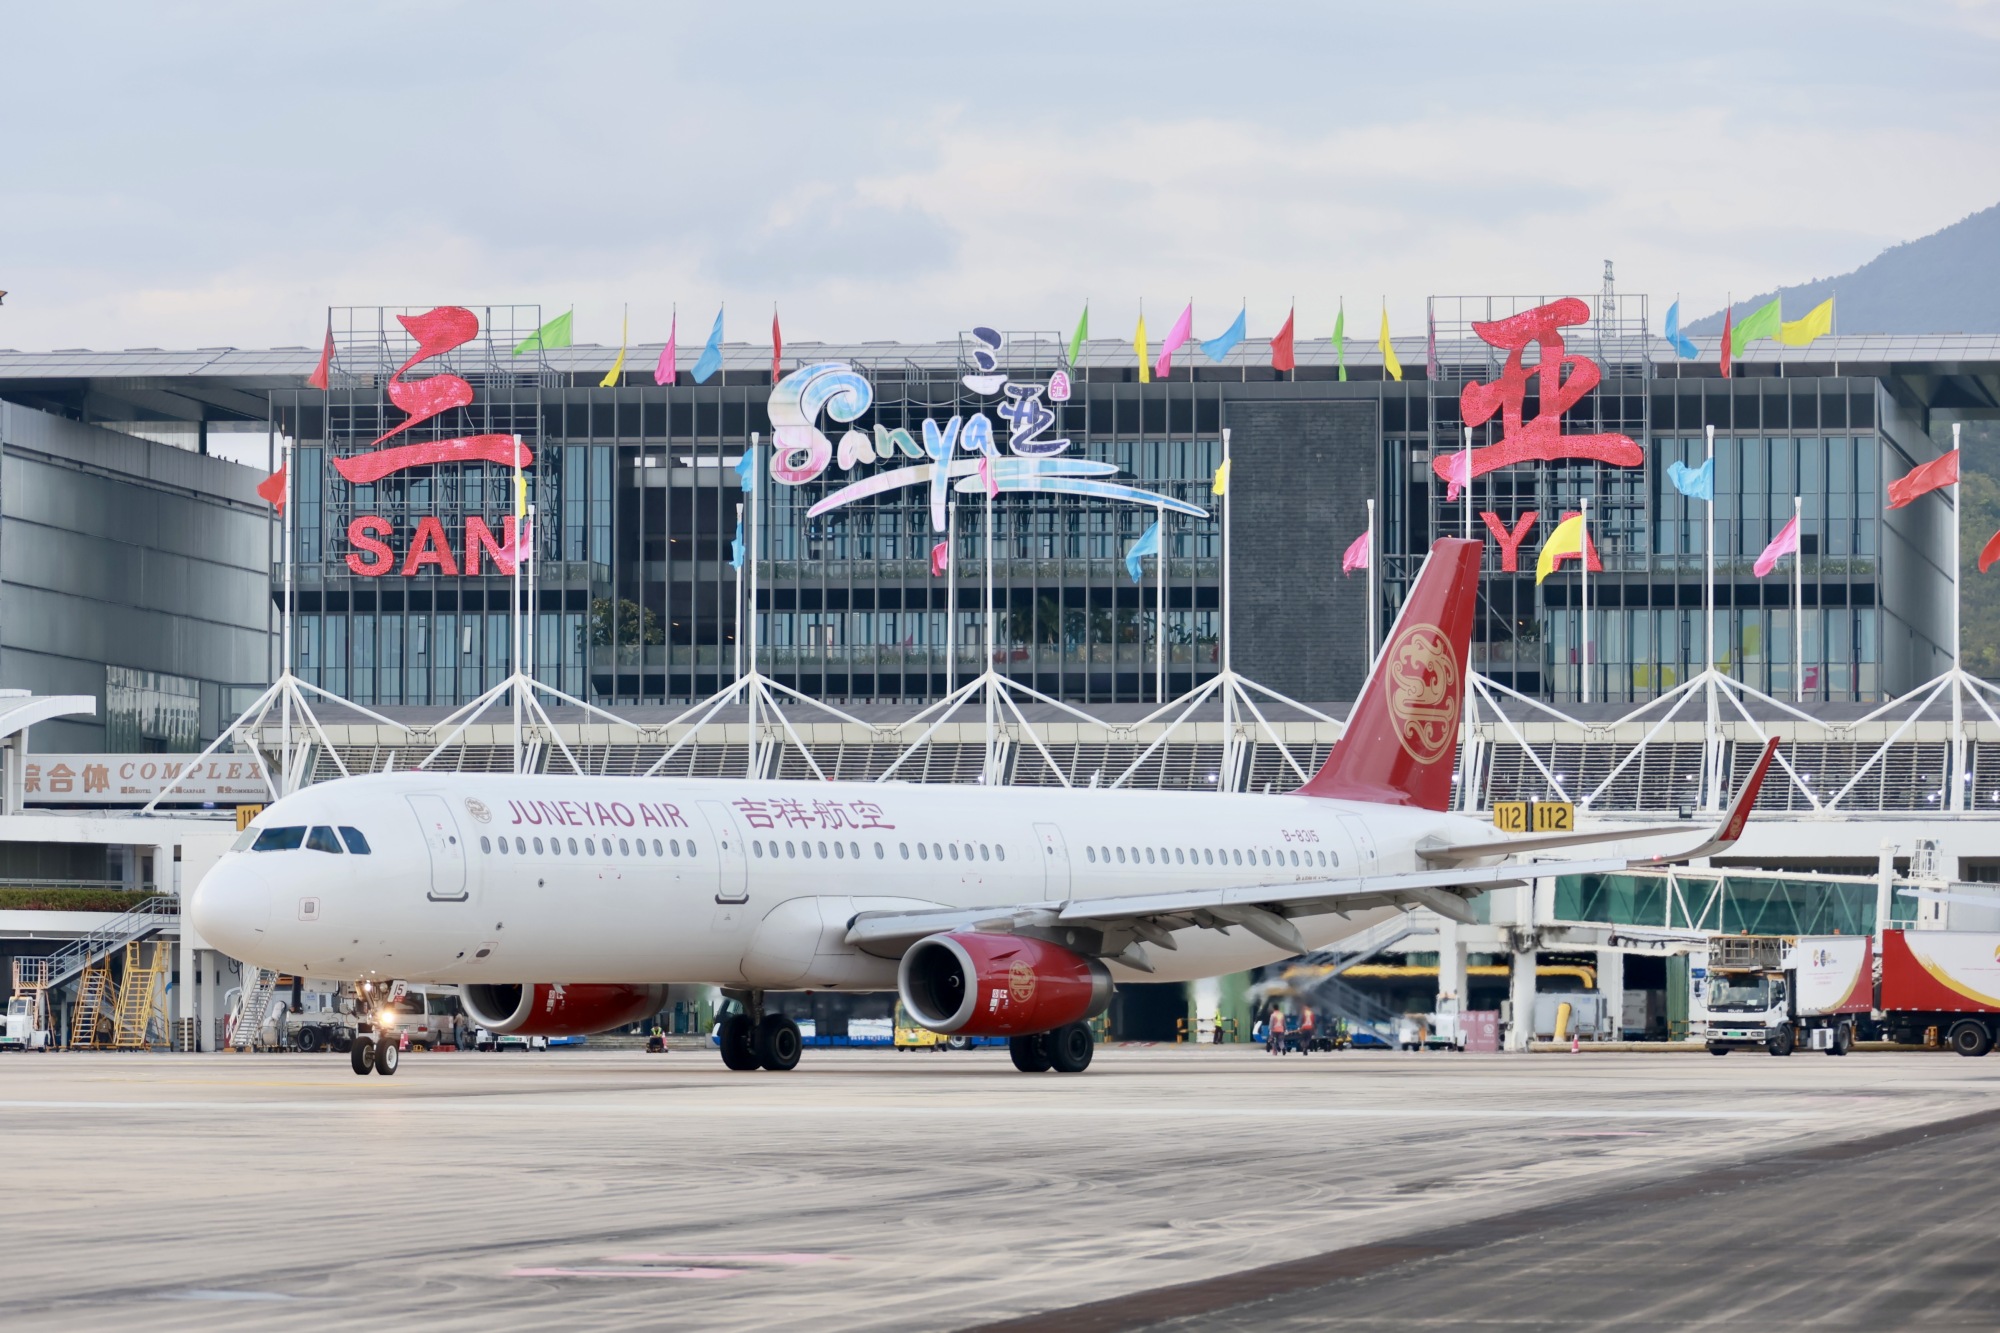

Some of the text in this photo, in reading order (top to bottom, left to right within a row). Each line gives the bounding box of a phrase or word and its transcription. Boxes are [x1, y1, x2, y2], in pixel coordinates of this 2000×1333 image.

[332, 305, 533, 483] 三
[1433, 297, 1644, 483] 亚
[768, 362, 1002, 532] Sanya
[345, 515, 518, 577] SAN
[1479, 511, 1604, 573] YA
[119, 762, 263, 780] COMPLEX
[242, 809, 259, 830] 11
[508, 800, 690, 829] JUNEYAO AIR
[732, 797, 896, 830] 吉祥航空
[1499, 807, 1521, 829] 112
[1539, 807, 1567, 829] 112
[1281, 829, 1320, 843] B-8315
